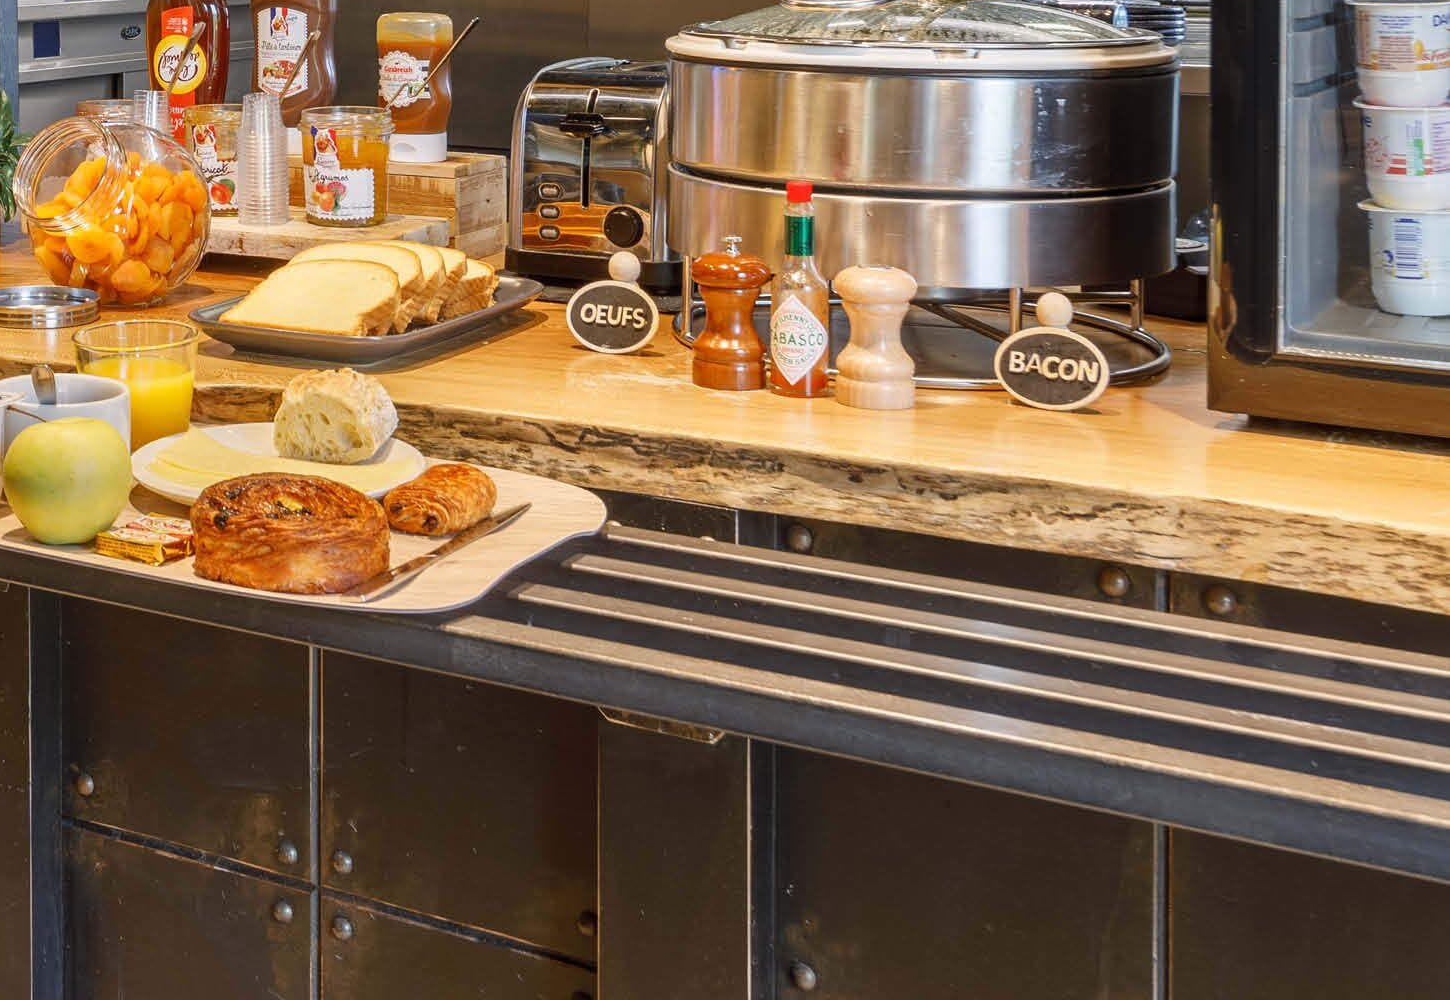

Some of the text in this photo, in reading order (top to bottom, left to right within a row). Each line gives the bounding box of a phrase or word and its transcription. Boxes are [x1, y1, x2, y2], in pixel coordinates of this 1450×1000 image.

[580, 303, 646, 329] OEUFS
[772, 331, 824, 347] ABASCO
[1008, 350, 1100, 383] BACON
